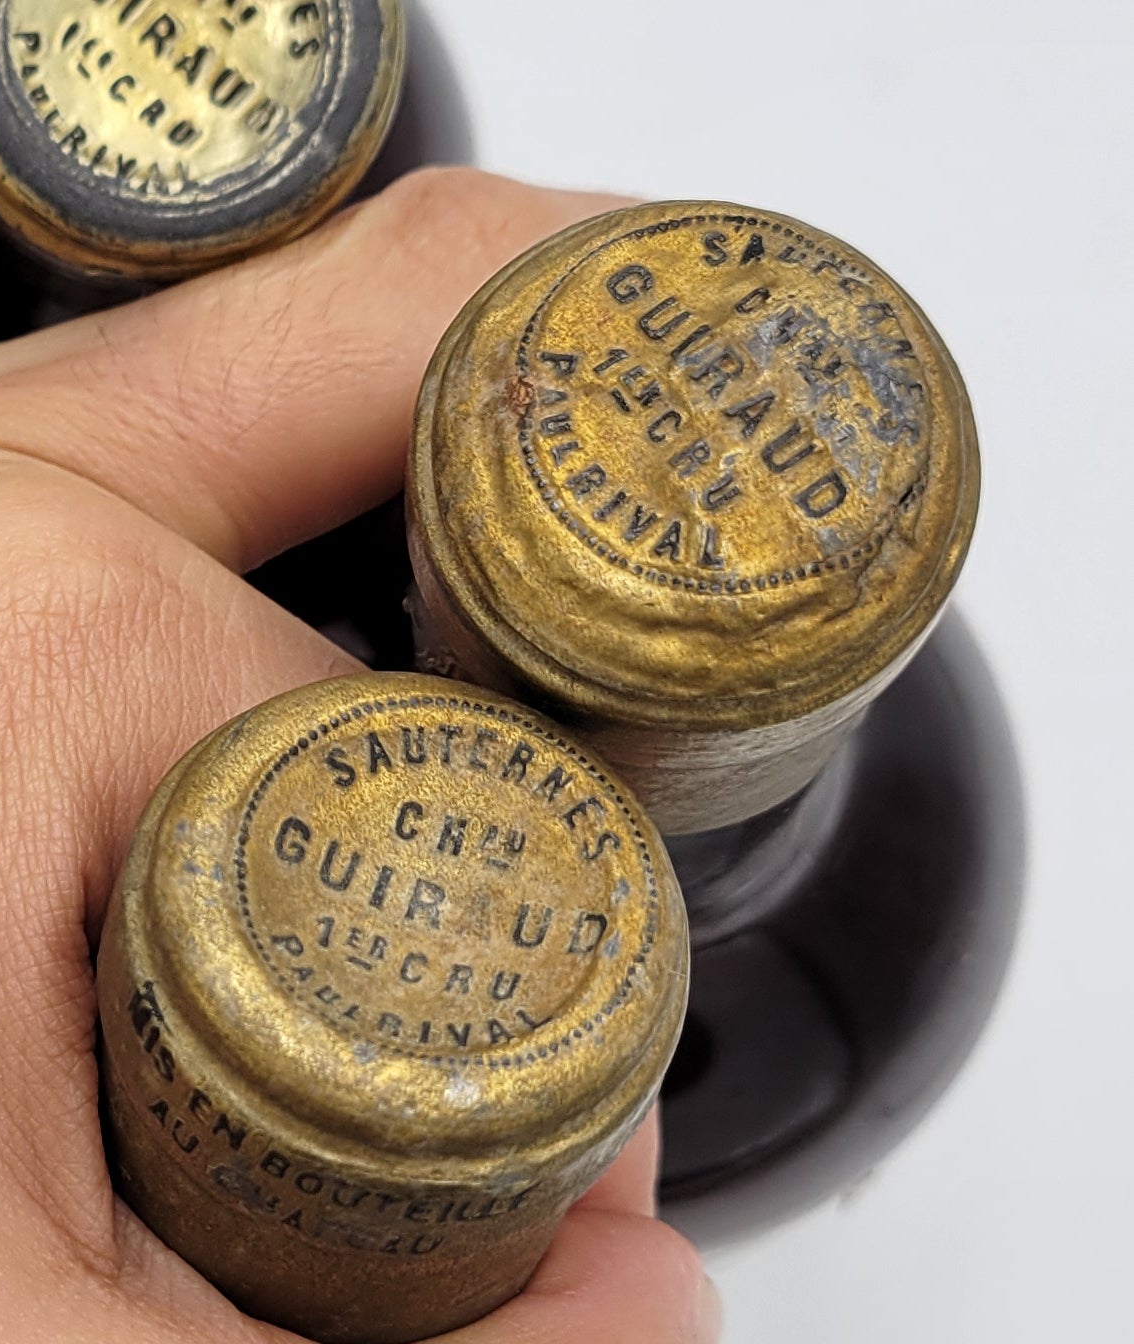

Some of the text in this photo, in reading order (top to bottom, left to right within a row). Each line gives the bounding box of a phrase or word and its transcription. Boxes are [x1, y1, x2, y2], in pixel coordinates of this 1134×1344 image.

[108, 74, 201, 147] CRU
[606, 263, 849, 519] GUIRAUD
[648, 410, 741, 513] CRU
[325, 722, 621, 863] SAUTERNES
[273, 816, 609, 957] GUIRUD
[400, 952, 522, 1001] CRU
[147, 1097, 200, 1155] AU
[189, 1086, 246, 1152] EN
